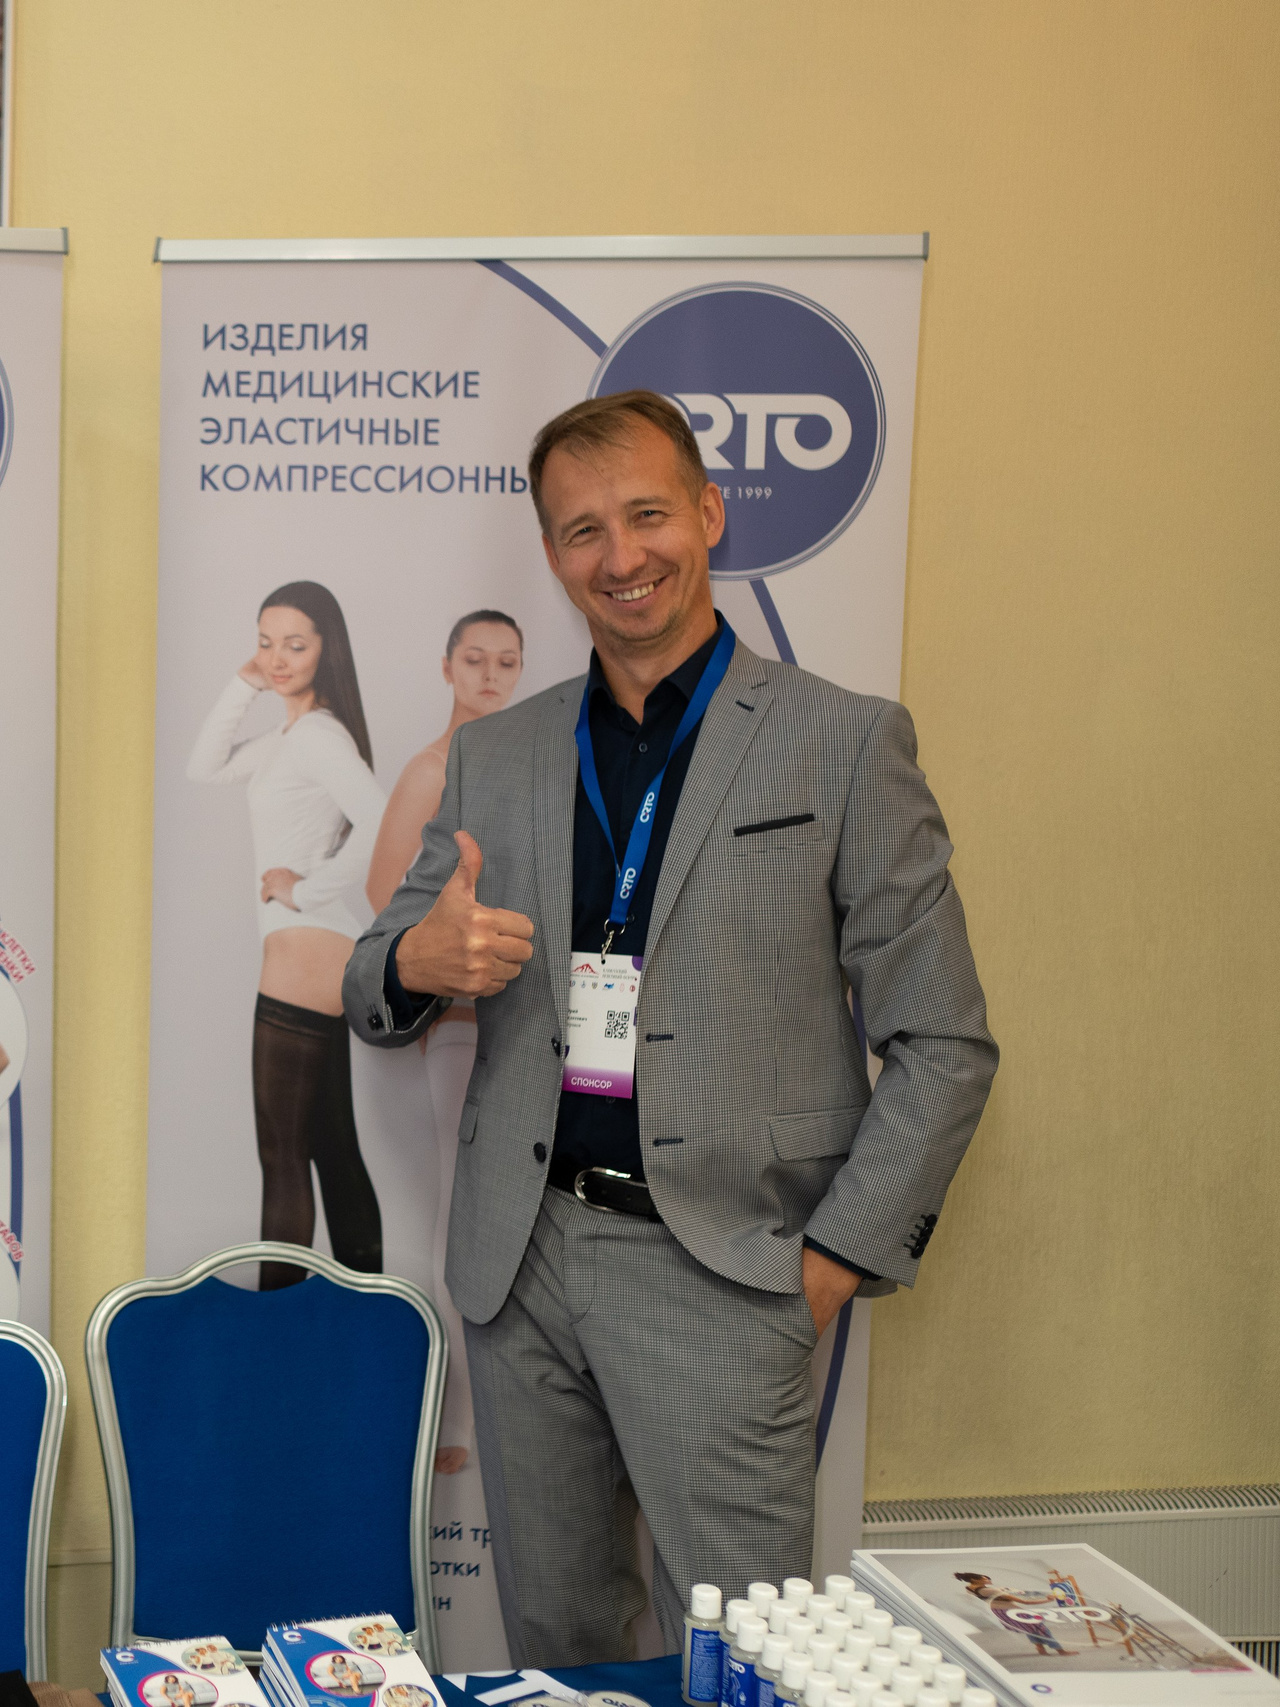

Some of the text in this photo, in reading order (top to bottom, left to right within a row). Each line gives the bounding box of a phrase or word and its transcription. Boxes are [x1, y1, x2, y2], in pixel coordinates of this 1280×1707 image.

[203, 323, 369, 356] ИЗДЕЛИЯ
[202, 370, 481, 403] МЕДИЦИНСКИЕ
[200, 417, 440, 446] ЭЛАСТИЧНЫЕ
[662, 393, 852, 471] RTO
[738, 486, 773, 500] 1999
[640, 791, 655, 823] ORTO
[620, 867, 637, 899] ORTO
[0, 931, 36, 975] КЛЕТКИ
[571, 1076, 613, 1090] СПОНСОР
